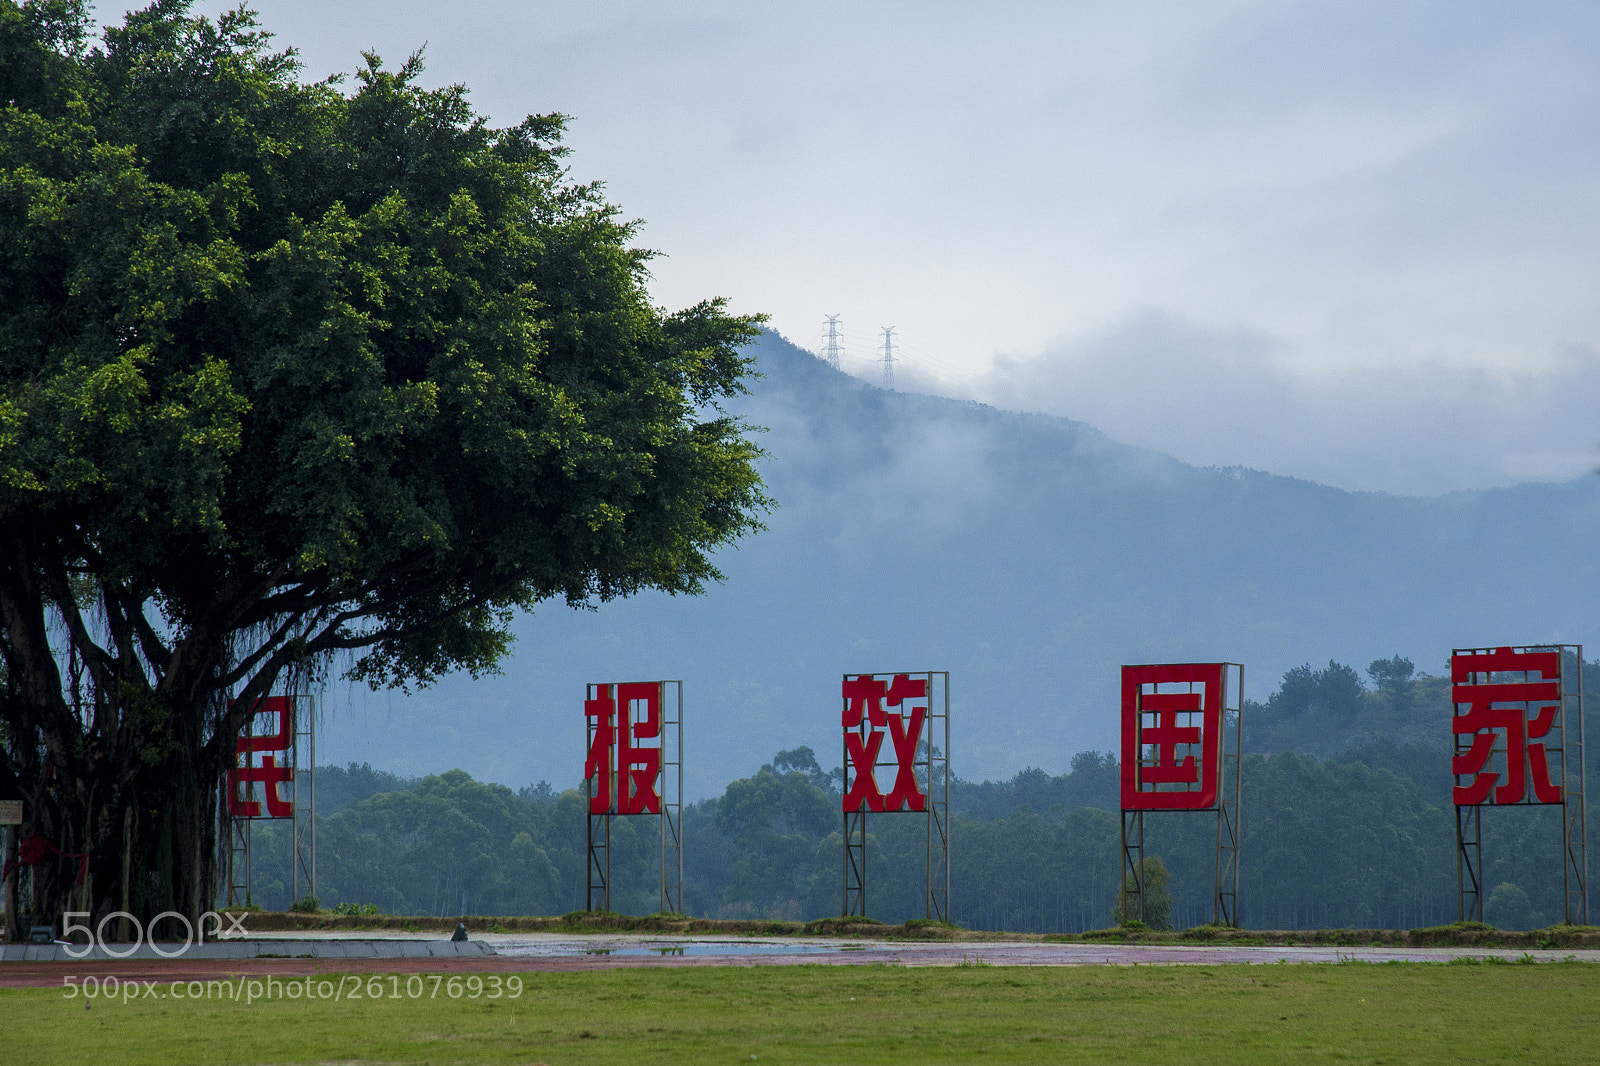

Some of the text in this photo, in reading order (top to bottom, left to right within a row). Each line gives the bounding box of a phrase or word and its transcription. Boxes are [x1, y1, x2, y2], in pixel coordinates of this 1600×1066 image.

[585, 683, 662, 814] 报
[842, 674, 927, 812] 效
[1121, 663, 1221, 809] 国
[1452, 646, 1562, 805] 家
